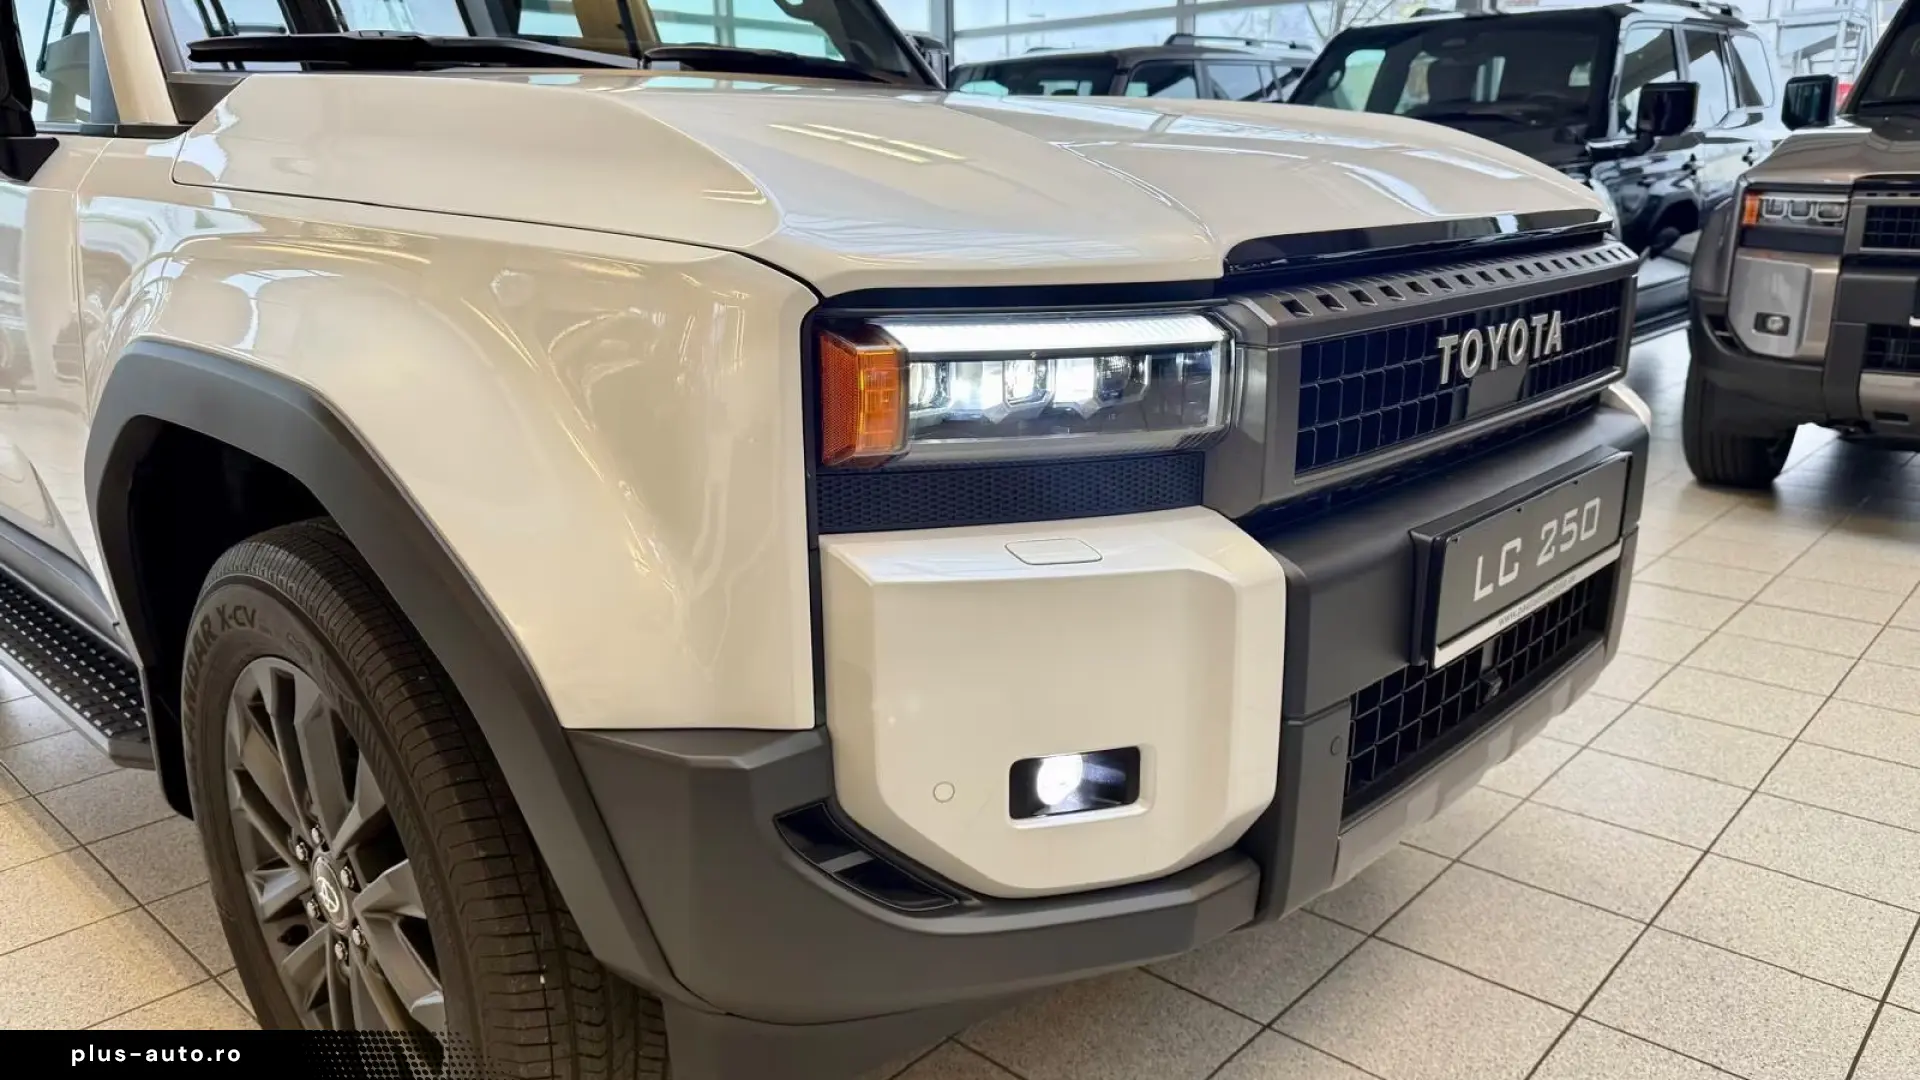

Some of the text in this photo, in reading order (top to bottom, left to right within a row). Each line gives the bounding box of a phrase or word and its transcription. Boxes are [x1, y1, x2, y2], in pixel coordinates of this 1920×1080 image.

[1437, 310, 1562, 385] TOYOTA
[1473, 537, 1522, 602] LC
[1536, 497, 1601, 566] 250
